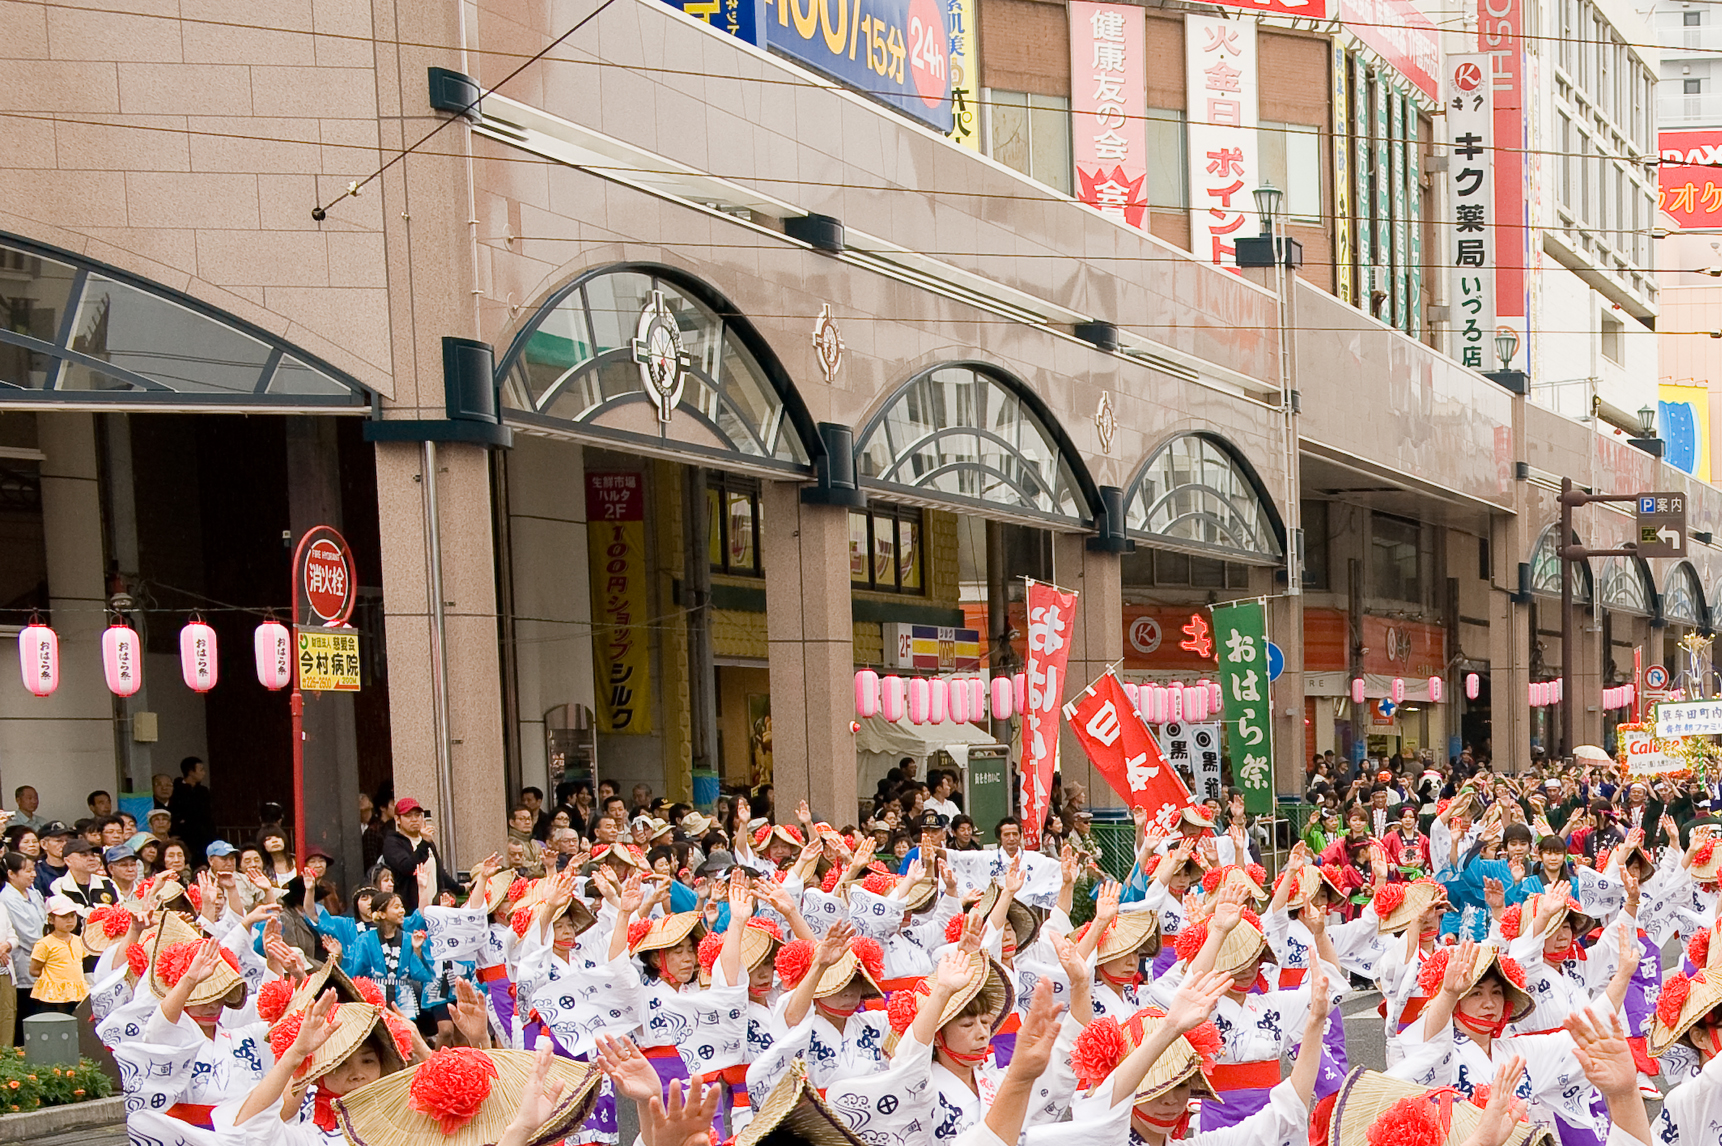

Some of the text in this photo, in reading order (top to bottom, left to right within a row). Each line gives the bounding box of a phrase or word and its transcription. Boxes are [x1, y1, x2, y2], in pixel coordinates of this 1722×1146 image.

[910, 16, 946, 81] 24h
[1089, 9, 1128, 161] 健康友の会
[1455, 132, 1485, 368] キク薬局 いづろ店
[604, 503, 627, 519] 2F
[1656, 497, 1683, 513] 案内
[309, 563, 345, 596] 消火栓
[39, 641, 51, 681] おはら祭
[118, 641, 131, 680] おはら祭
[196, 638, 209, 677] おはら祭
[300, 651, 359, 677] 今村病院
[899, 634, 911, 658] 2F
[1225, 628, 1270, 791] おはら祭
